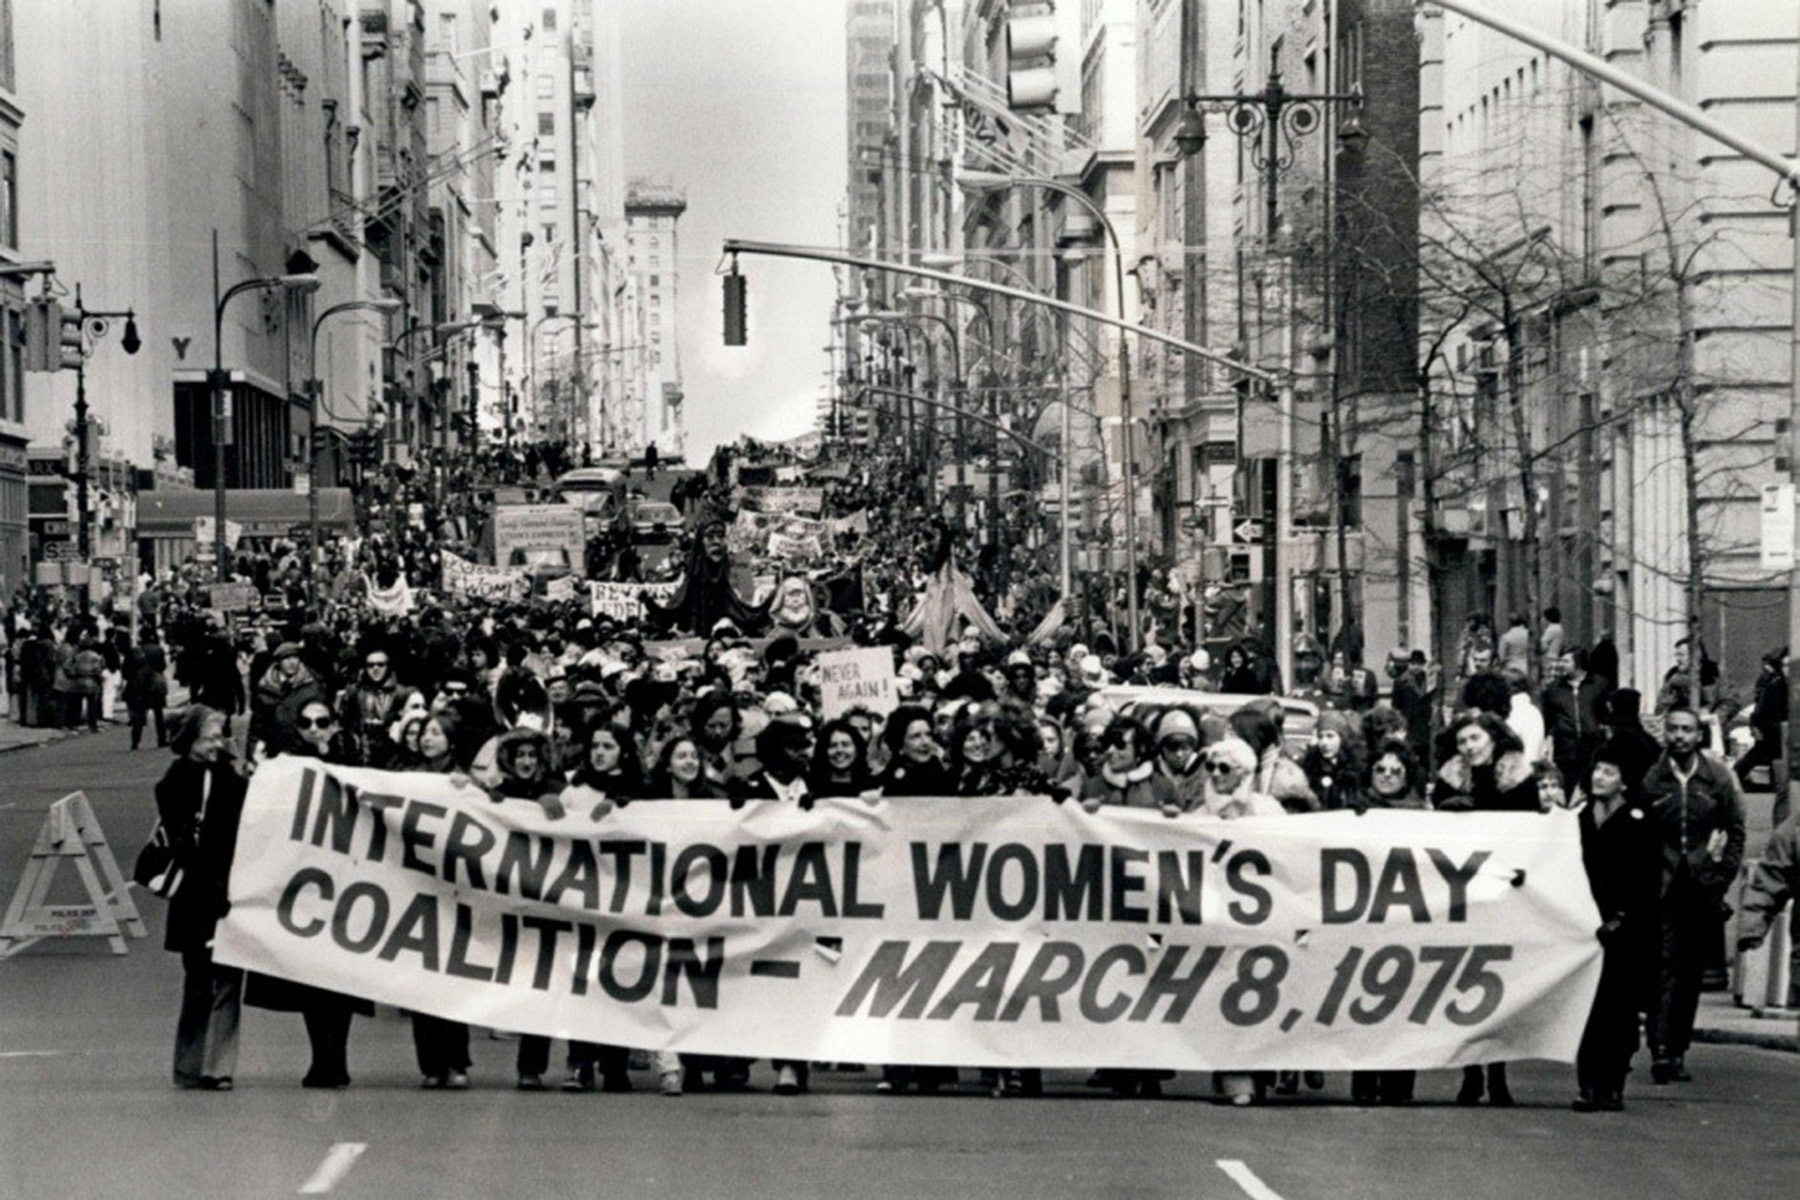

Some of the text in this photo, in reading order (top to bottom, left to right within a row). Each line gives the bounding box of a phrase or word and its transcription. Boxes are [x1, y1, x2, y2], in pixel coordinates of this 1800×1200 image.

[172, 337, 192, 361] Y
[822, 663, 860, 684] NEVER
[837, 679, 889, 700] AGAIN!
[290, 768, 1492, 925] INTERNATIONAL WOMEN'S DAY
[276, 867, 725, 1010] COALITION
[836, 941, 1226, 1023] MARCH
